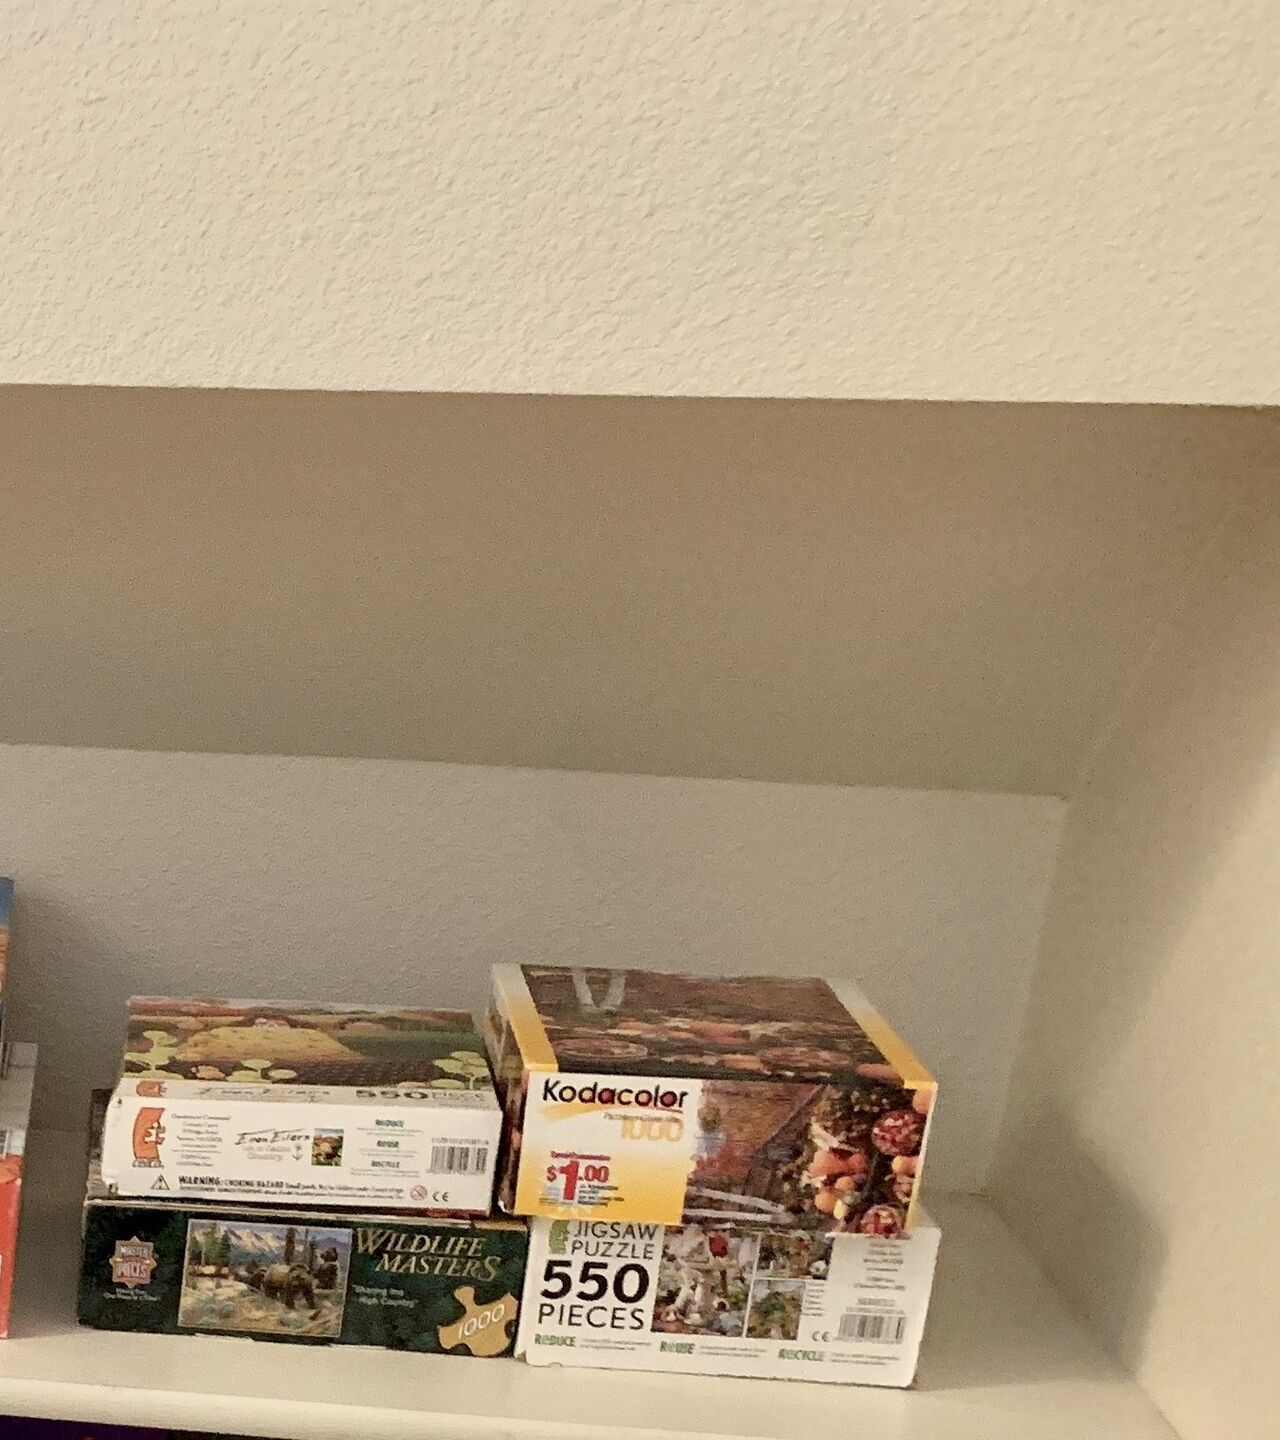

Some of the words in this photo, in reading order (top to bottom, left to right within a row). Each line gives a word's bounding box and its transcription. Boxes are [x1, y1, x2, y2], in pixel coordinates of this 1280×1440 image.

[543, 1078, 689, 1108] Kodacolor
[547, 1160, 609, 1200] $1.00
[355, 1227, 486, 1258] WILDLIFE
[574, 1221, 660, 1240] JIGSAW
[571, 1240, 654, 1260] PUZZLE
[375, 1254, 502, 1282] MASTERS
[541, 1259, 650, 1303] 550
[458, 1304, 505, 1339] 1000
[538, 1303, 645, 1330] PIECES
